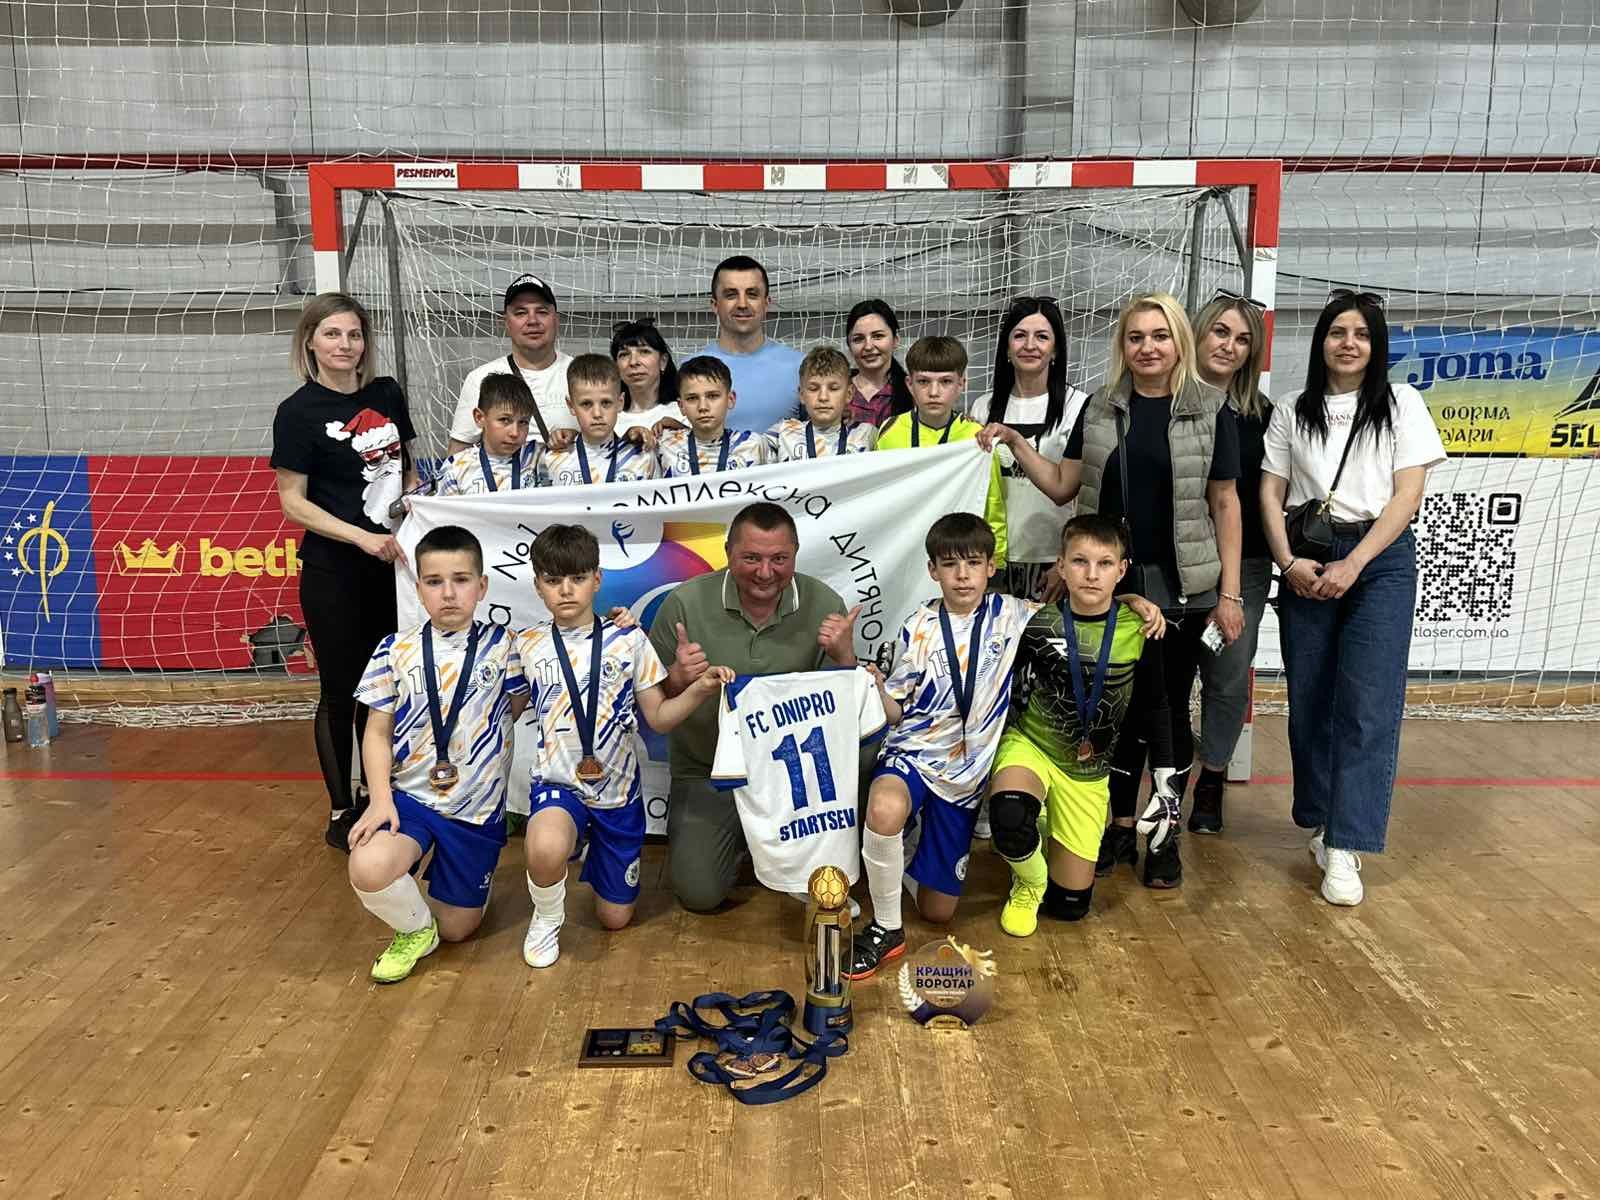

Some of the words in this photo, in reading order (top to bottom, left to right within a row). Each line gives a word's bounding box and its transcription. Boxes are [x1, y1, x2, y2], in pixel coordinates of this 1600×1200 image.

[396, 168, 456, 178] PESMENPOL
[1437, 427, 1495, 447] УАРИ
[746, 710, 770, 739] FC
[772, 690, 836, 728] DNIPRO
[771, 726, 837, 811] 11
[779, 808, 856, 842] STARTSEV
[916, 979, 975, 989] ВОРОТАР
